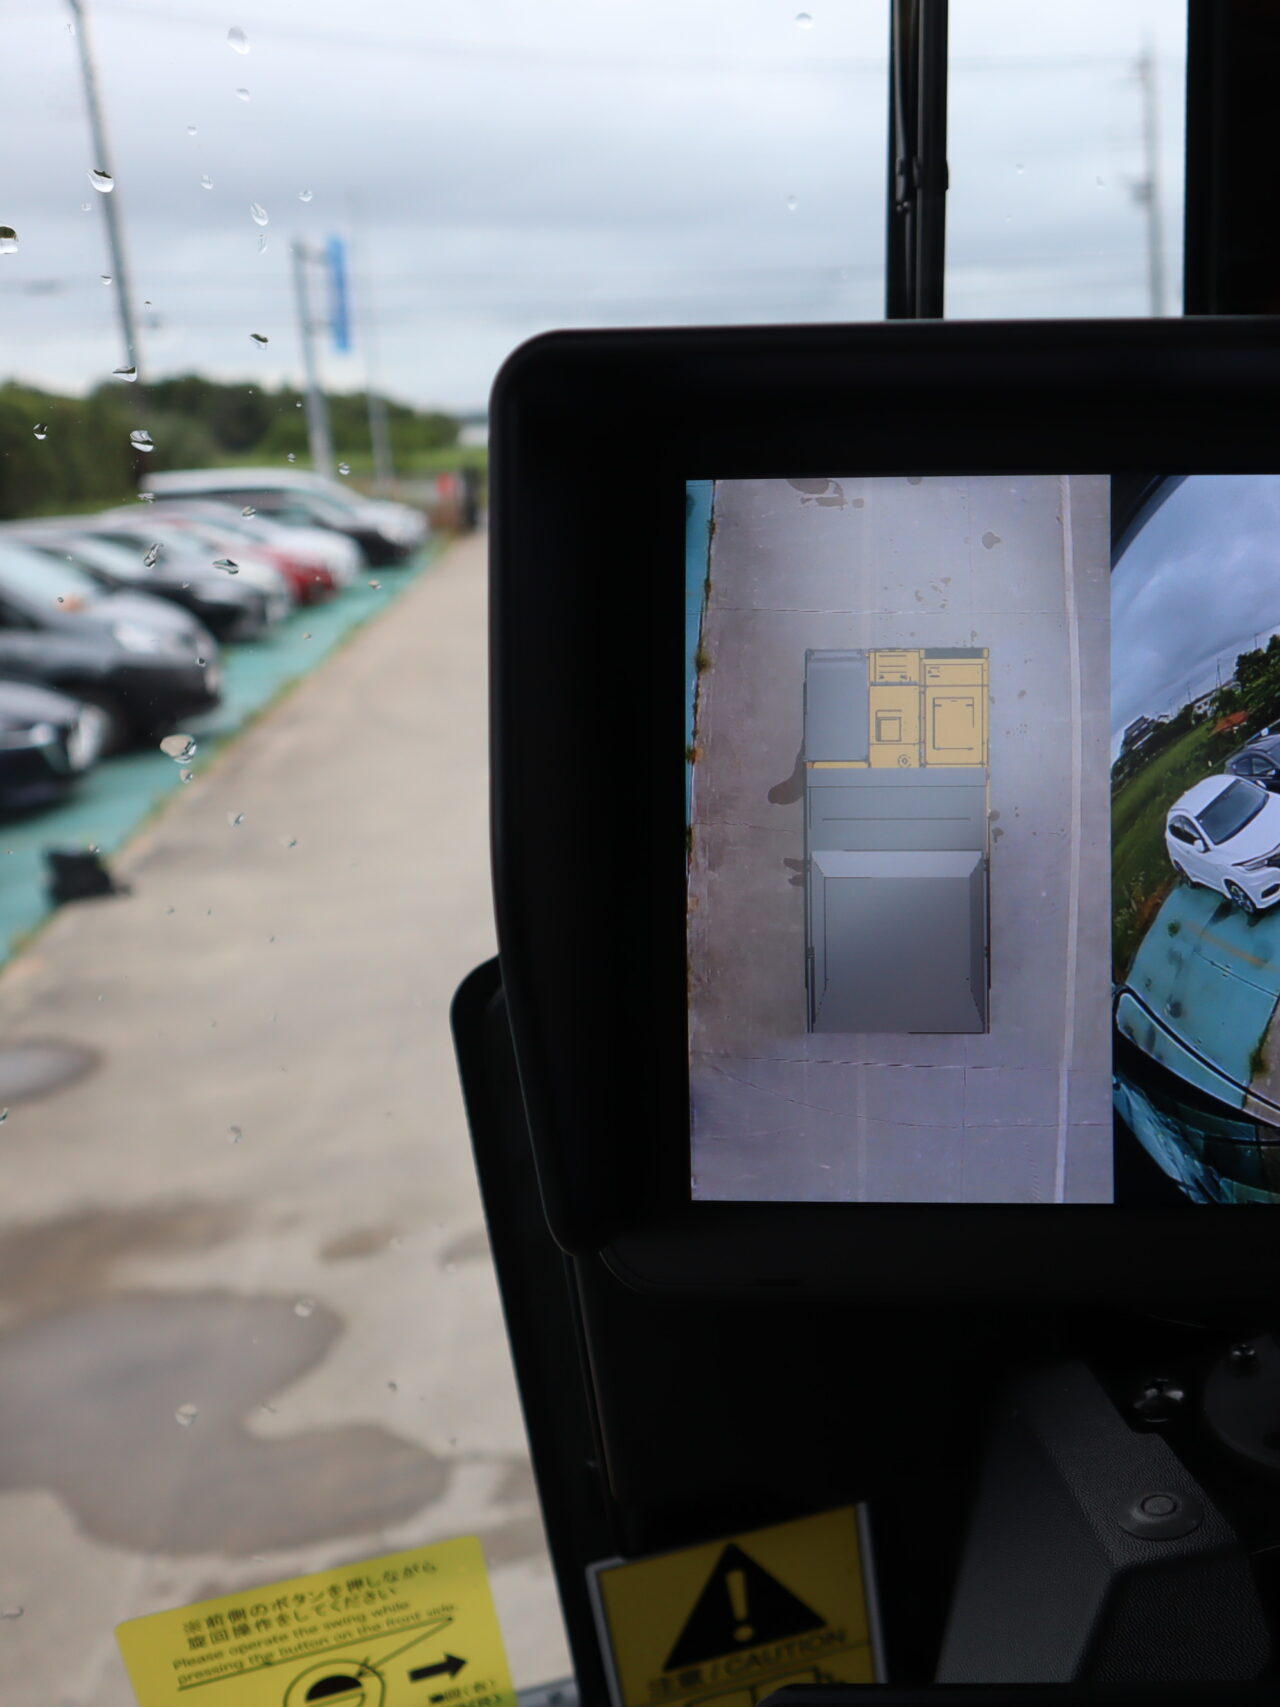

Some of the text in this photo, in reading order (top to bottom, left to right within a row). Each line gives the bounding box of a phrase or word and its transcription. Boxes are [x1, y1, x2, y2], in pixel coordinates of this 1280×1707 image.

[173, 1601, 410, 1671] Please operate the swing while
[177, 1660, 244, 1687] pressing
[249, 1651, 274, 1666] the
[278, 1637, 329, 1656] button
[333, 1631, 352, 1643] on
[356, 1622, 382, 1637] the
[386, 1611, 421, 1627] front
